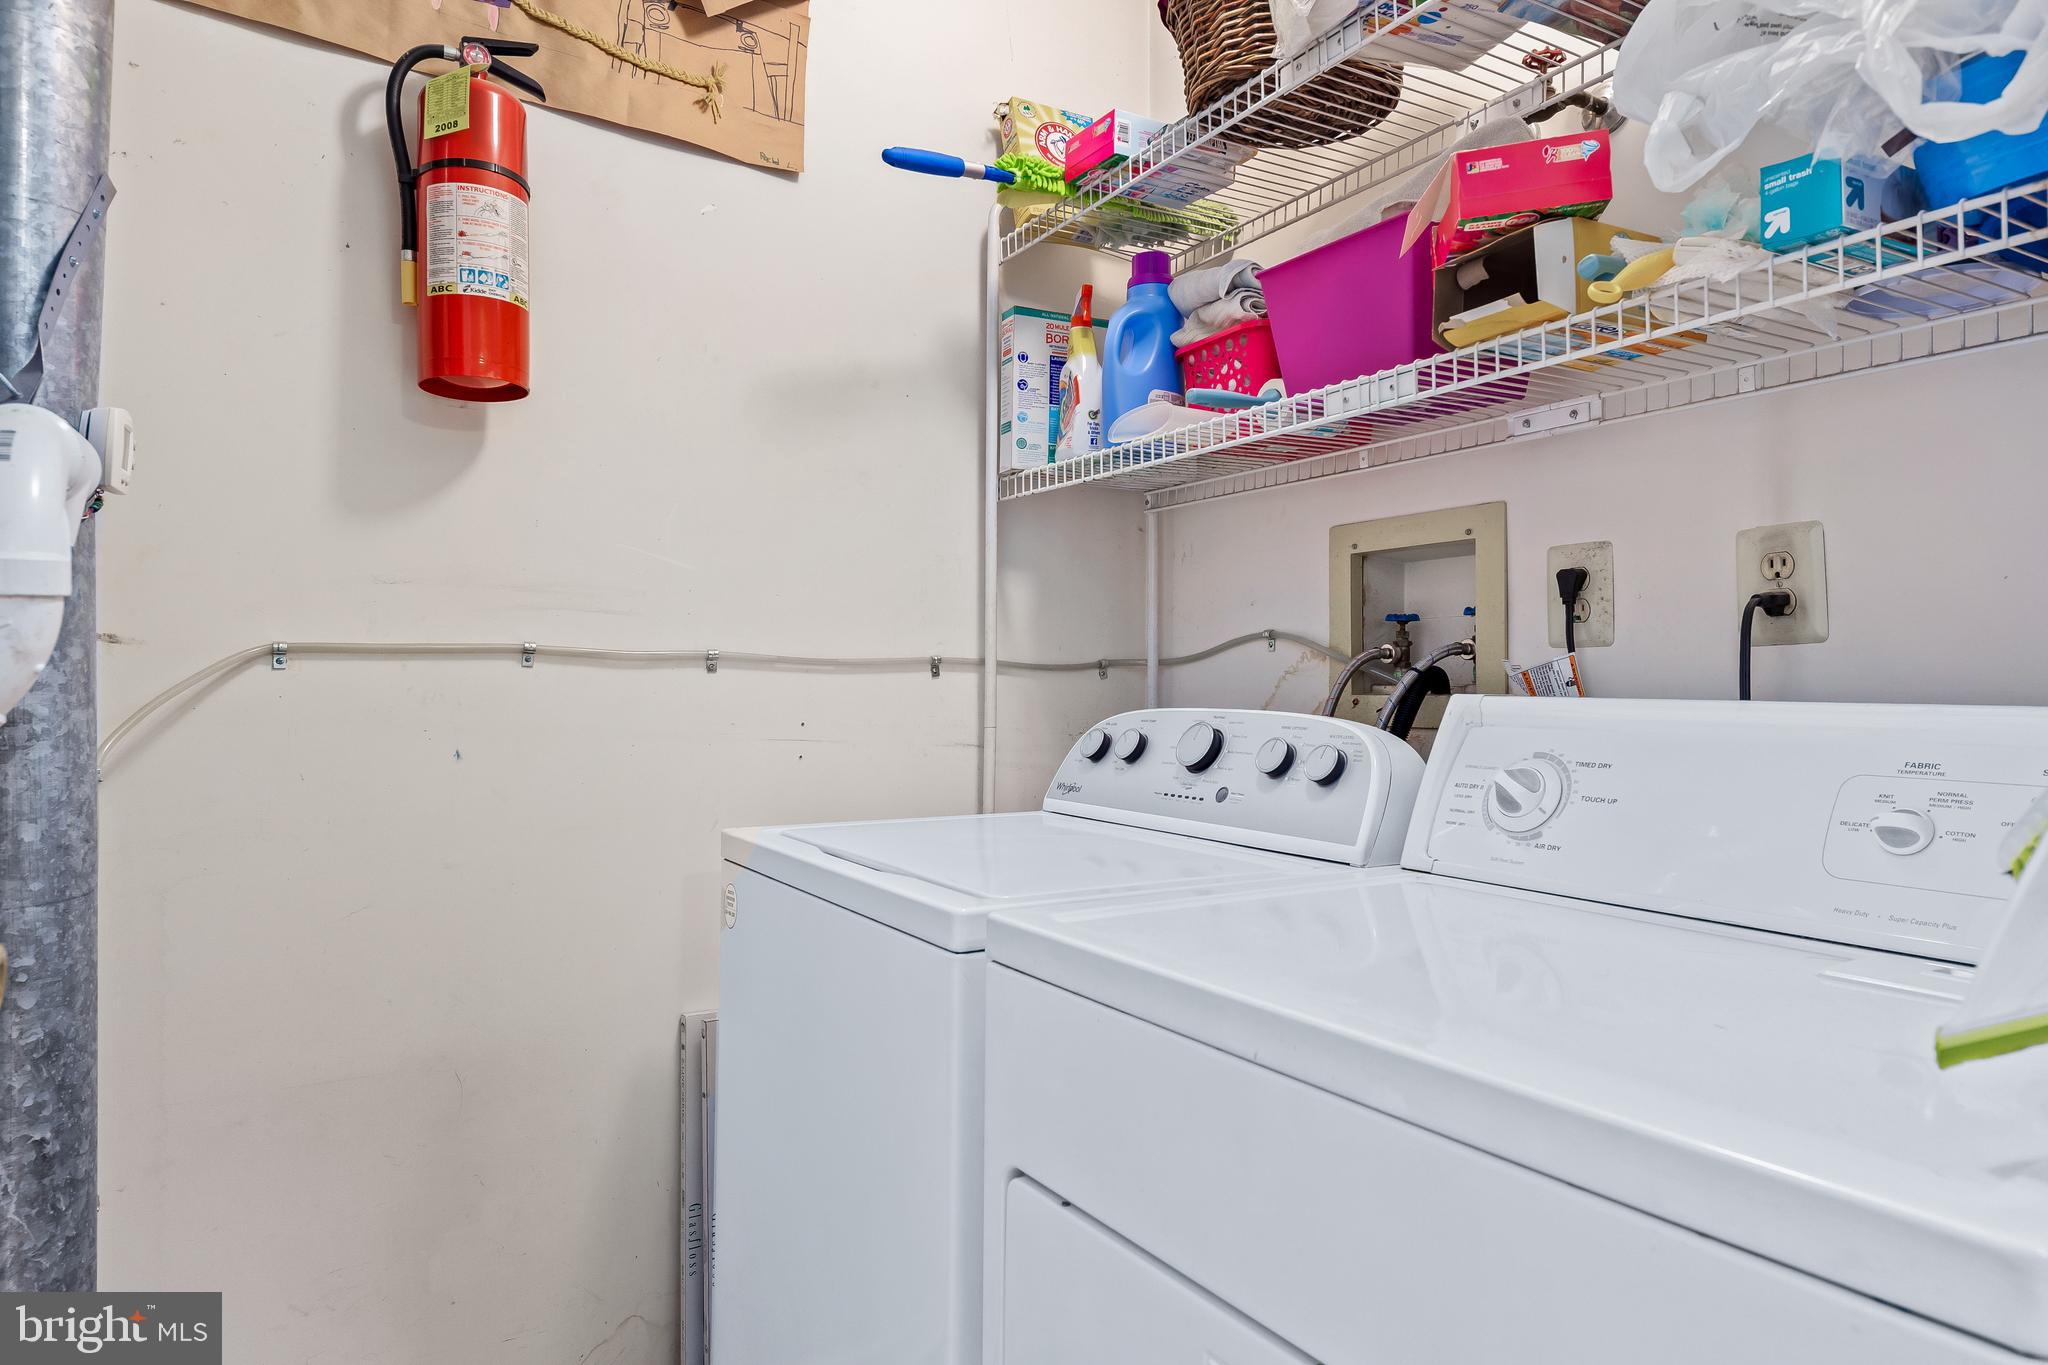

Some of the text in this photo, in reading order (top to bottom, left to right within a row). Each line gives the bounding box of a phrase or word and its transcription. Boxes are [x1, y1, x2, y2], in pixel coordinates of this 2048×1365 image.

[435, 120, 458, 133] 2008
[1038, 129, 1049, 148] ARM
[1047, 125, 1055, 133] &
[1764, 167, 1813, 190] small trash
[457, 185, 508, 200] INSTRUCTIONS
[430, 284, 453, 294] ABC
[470, 287, 487, 295] Kidde
[1045, 322, 1070, 331] 20 MULE
[1575, 761, 1596, 769] TIMED
[1904, 761, 1941, 770] FABRIC
[1896, 769, 1946, 777] TEMPERATURE
[1056, 782, 1083, 795] Whirlpool
[1937, 791, 1969, 799] NORMAL
[1580, 795, 1618, 805] TOUCH UP
[1929, 797, 1975, 806] PERM PRESS
[1839, 820, 1870, 829] DELICATE
[1945, 830, 1977, 839] COTTON
[1534, 842, 1546, 850] AIR
[1547, 843, 1562, 852] DRY
[1833, 906, 1957, 931] Heavy Duty Super Capacity Plus
